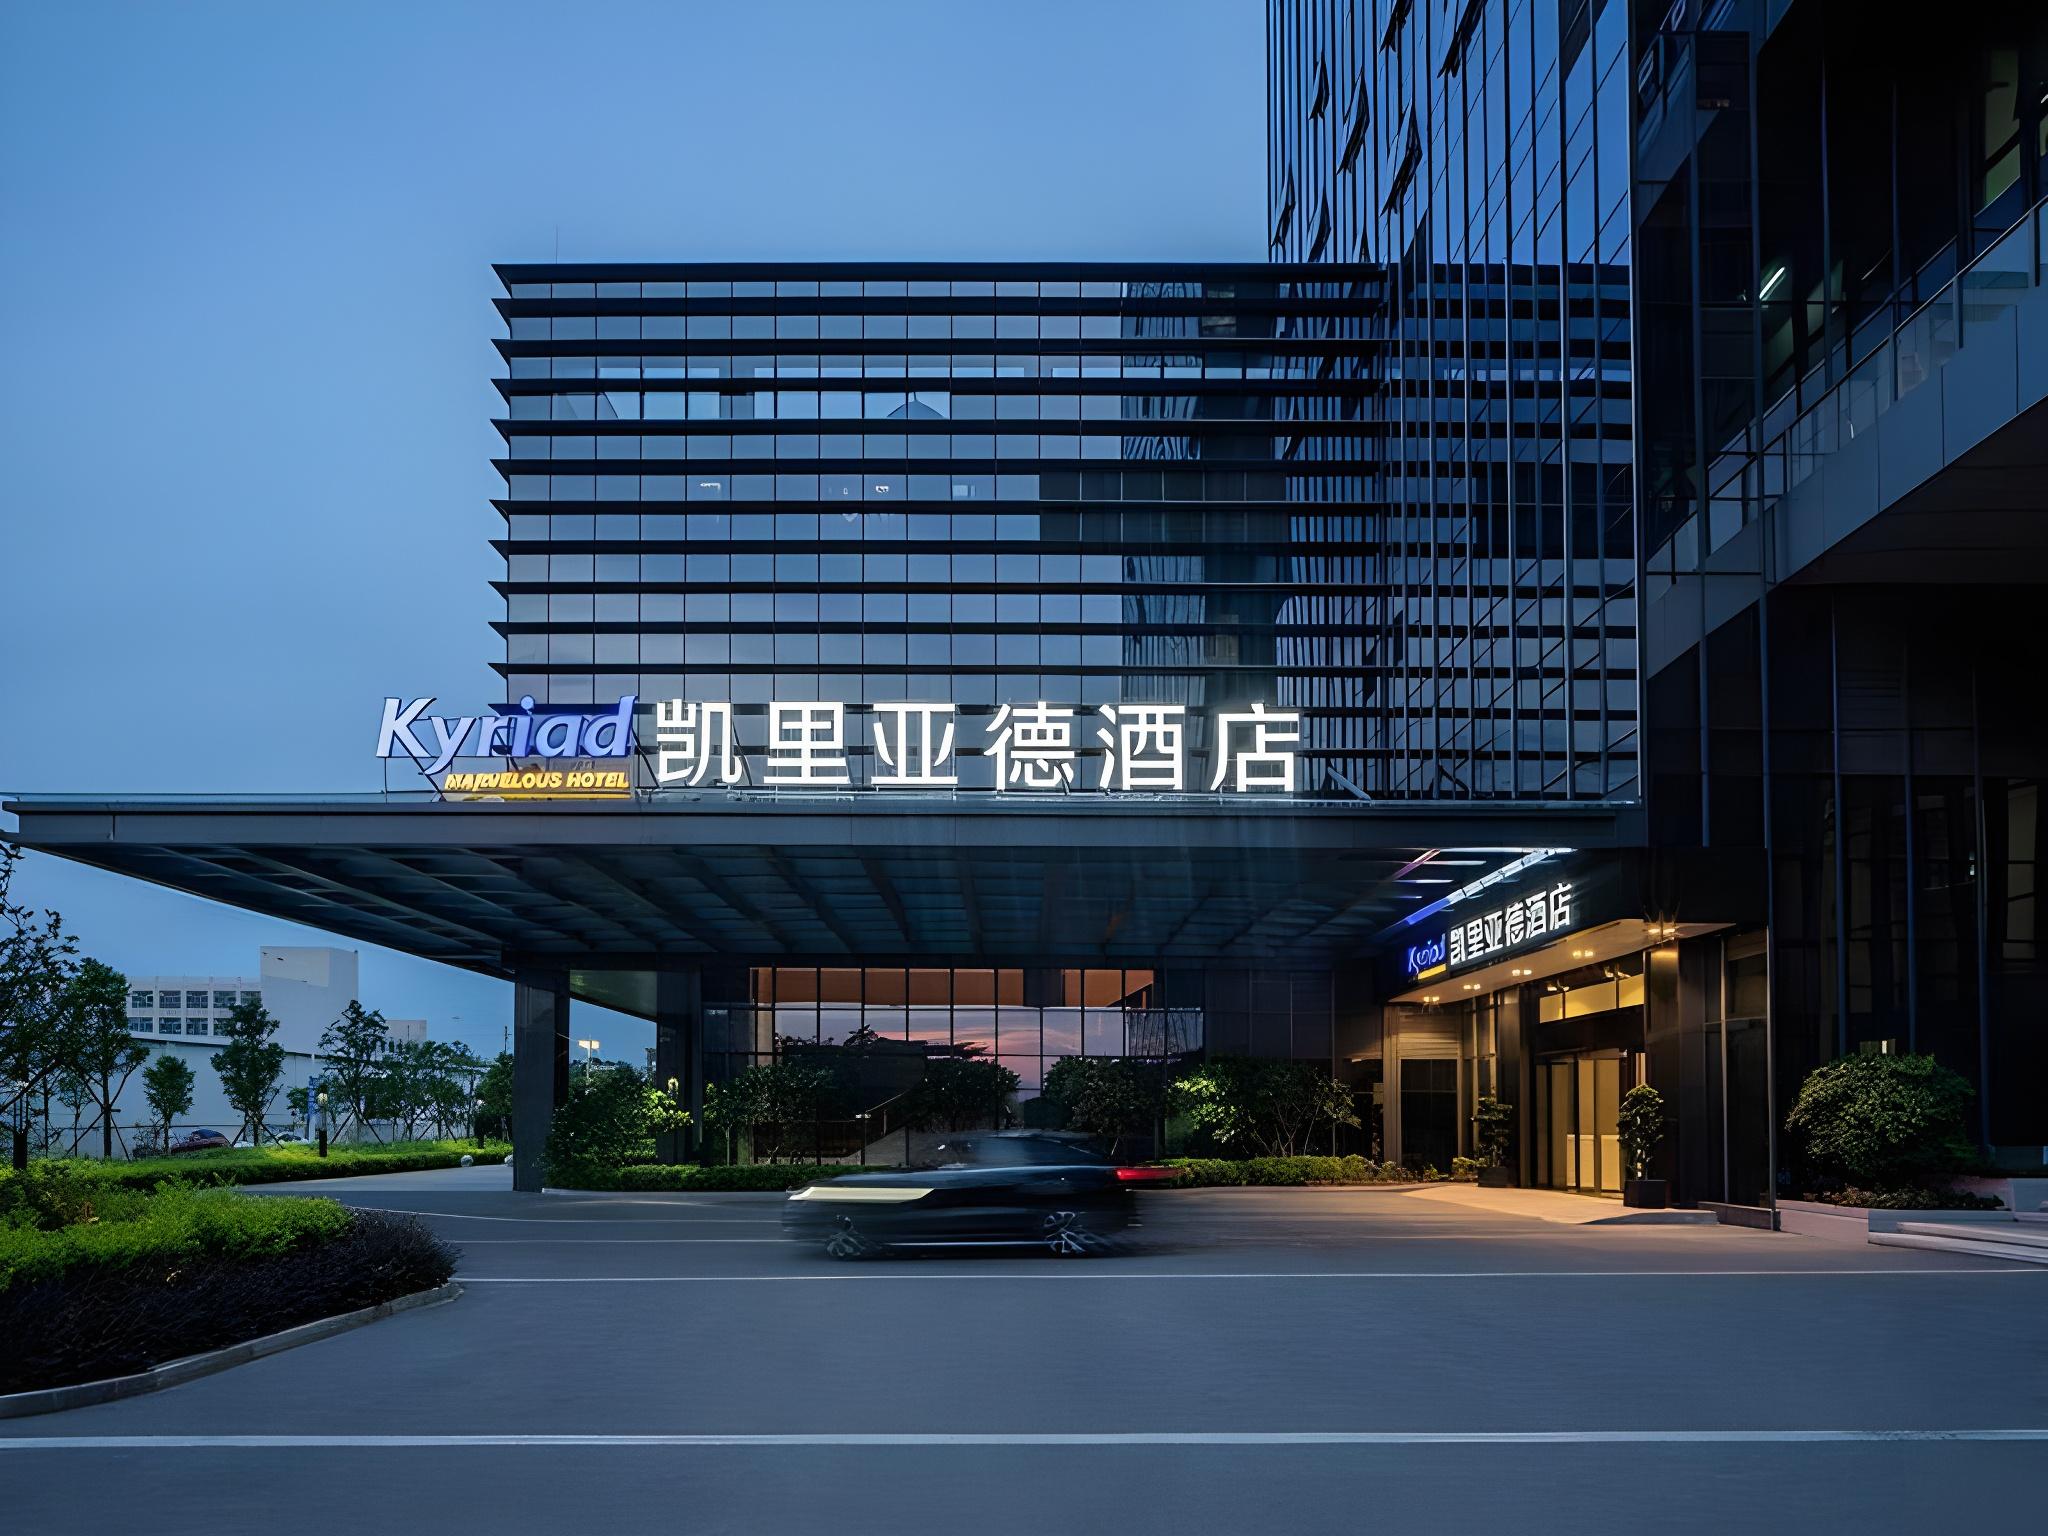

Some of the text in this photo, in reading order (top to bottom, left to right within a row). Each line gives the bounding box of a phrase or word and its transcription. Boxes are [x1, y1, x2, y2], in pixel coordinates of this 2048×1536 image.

[376, 695, 638, 774] Kyriad
[656, 699, 1301, 793] 凯里亚德酒店
